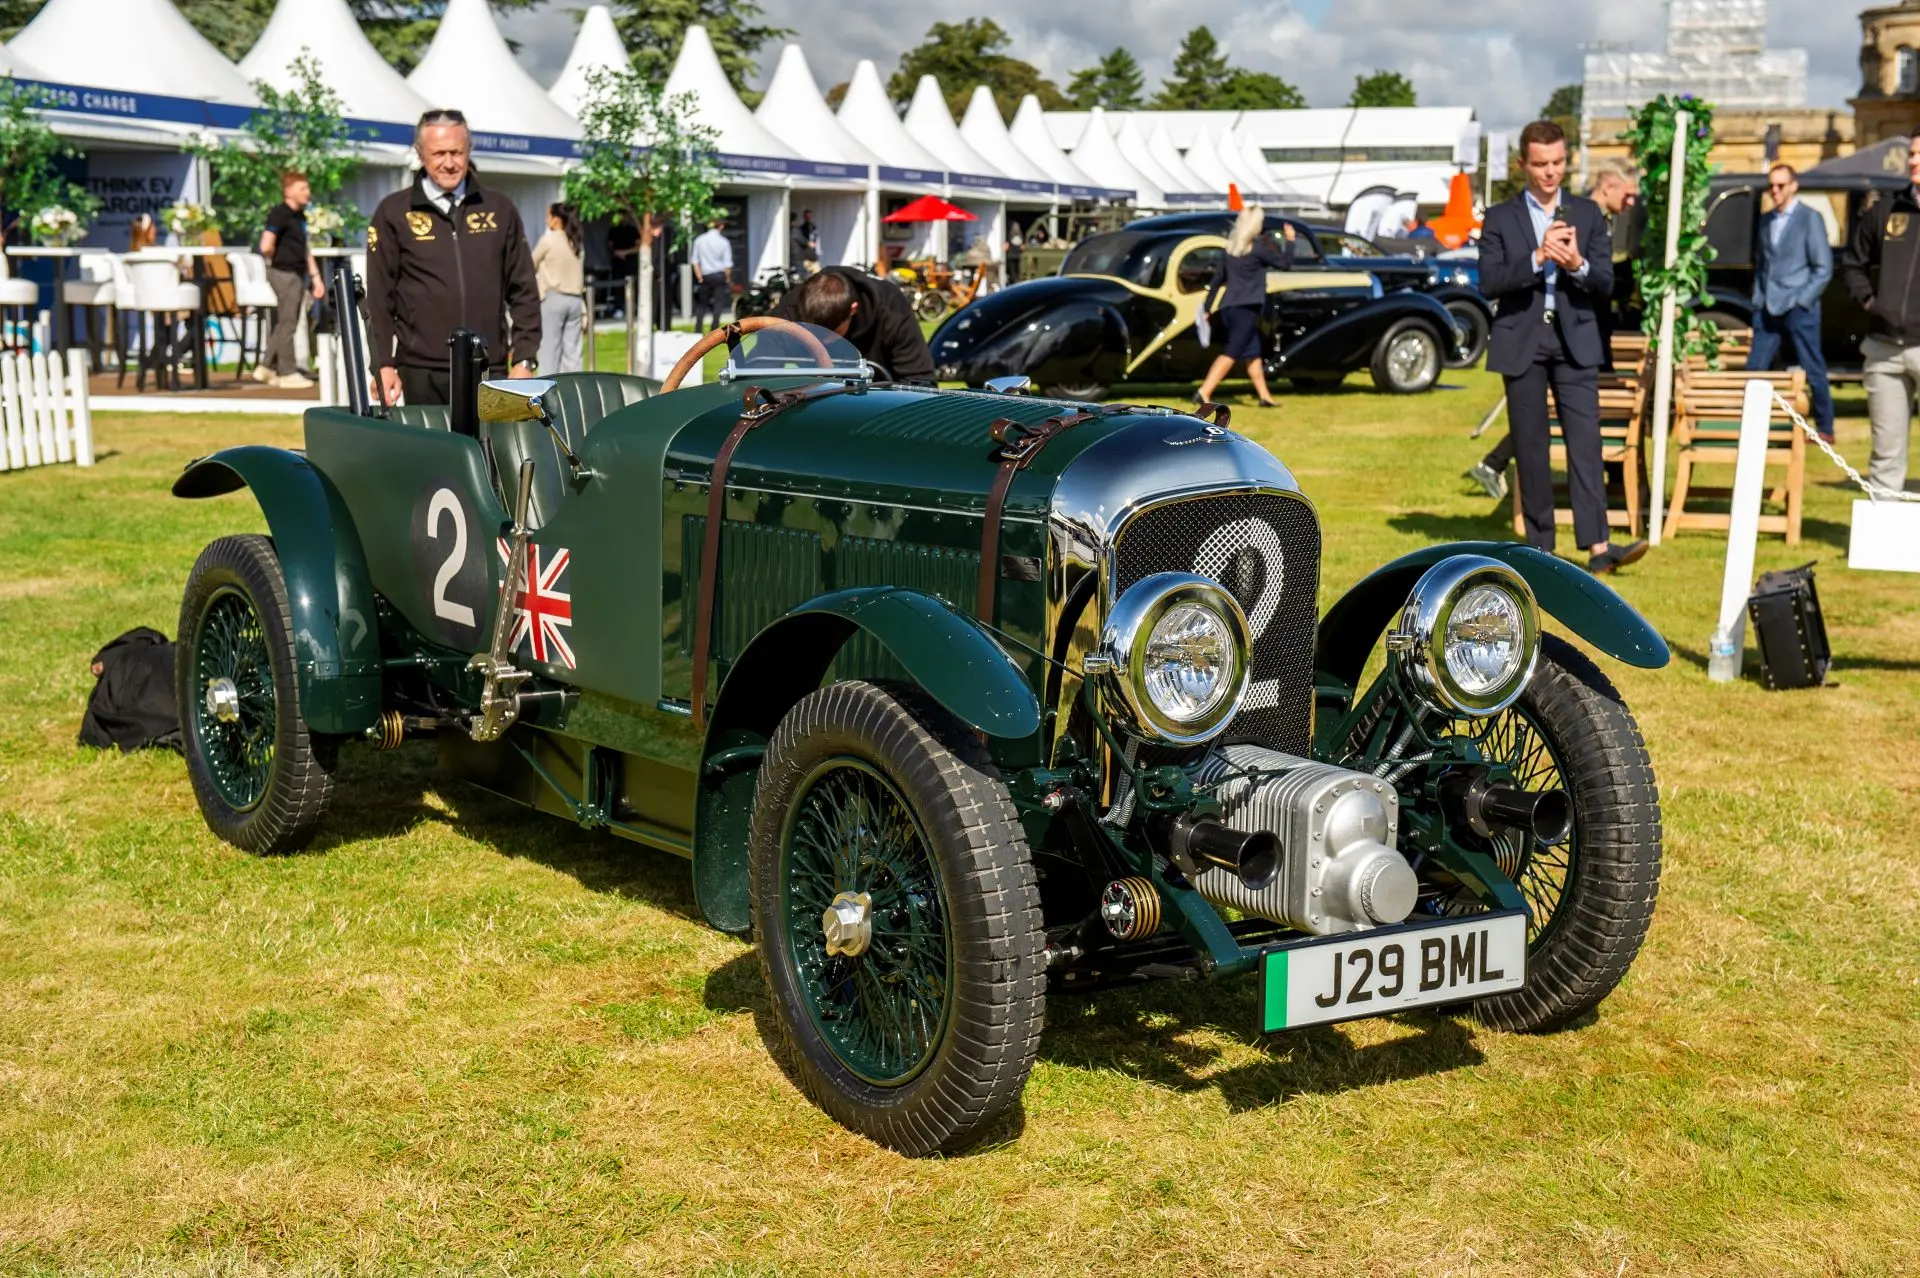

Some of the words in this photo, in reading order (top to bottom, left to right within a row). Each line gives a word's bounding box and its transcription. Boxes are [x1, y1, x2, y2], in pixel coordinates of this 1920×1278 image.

[83, 92, 138, 113] CHARGE
[149, 176, 175, 194] EV
[1204, 426, 1225, 435] B
[427, 487, 476, 628] 2
[1314, 943, 1405, 1009] J29
[1419, 929, 1504, 993] BML
